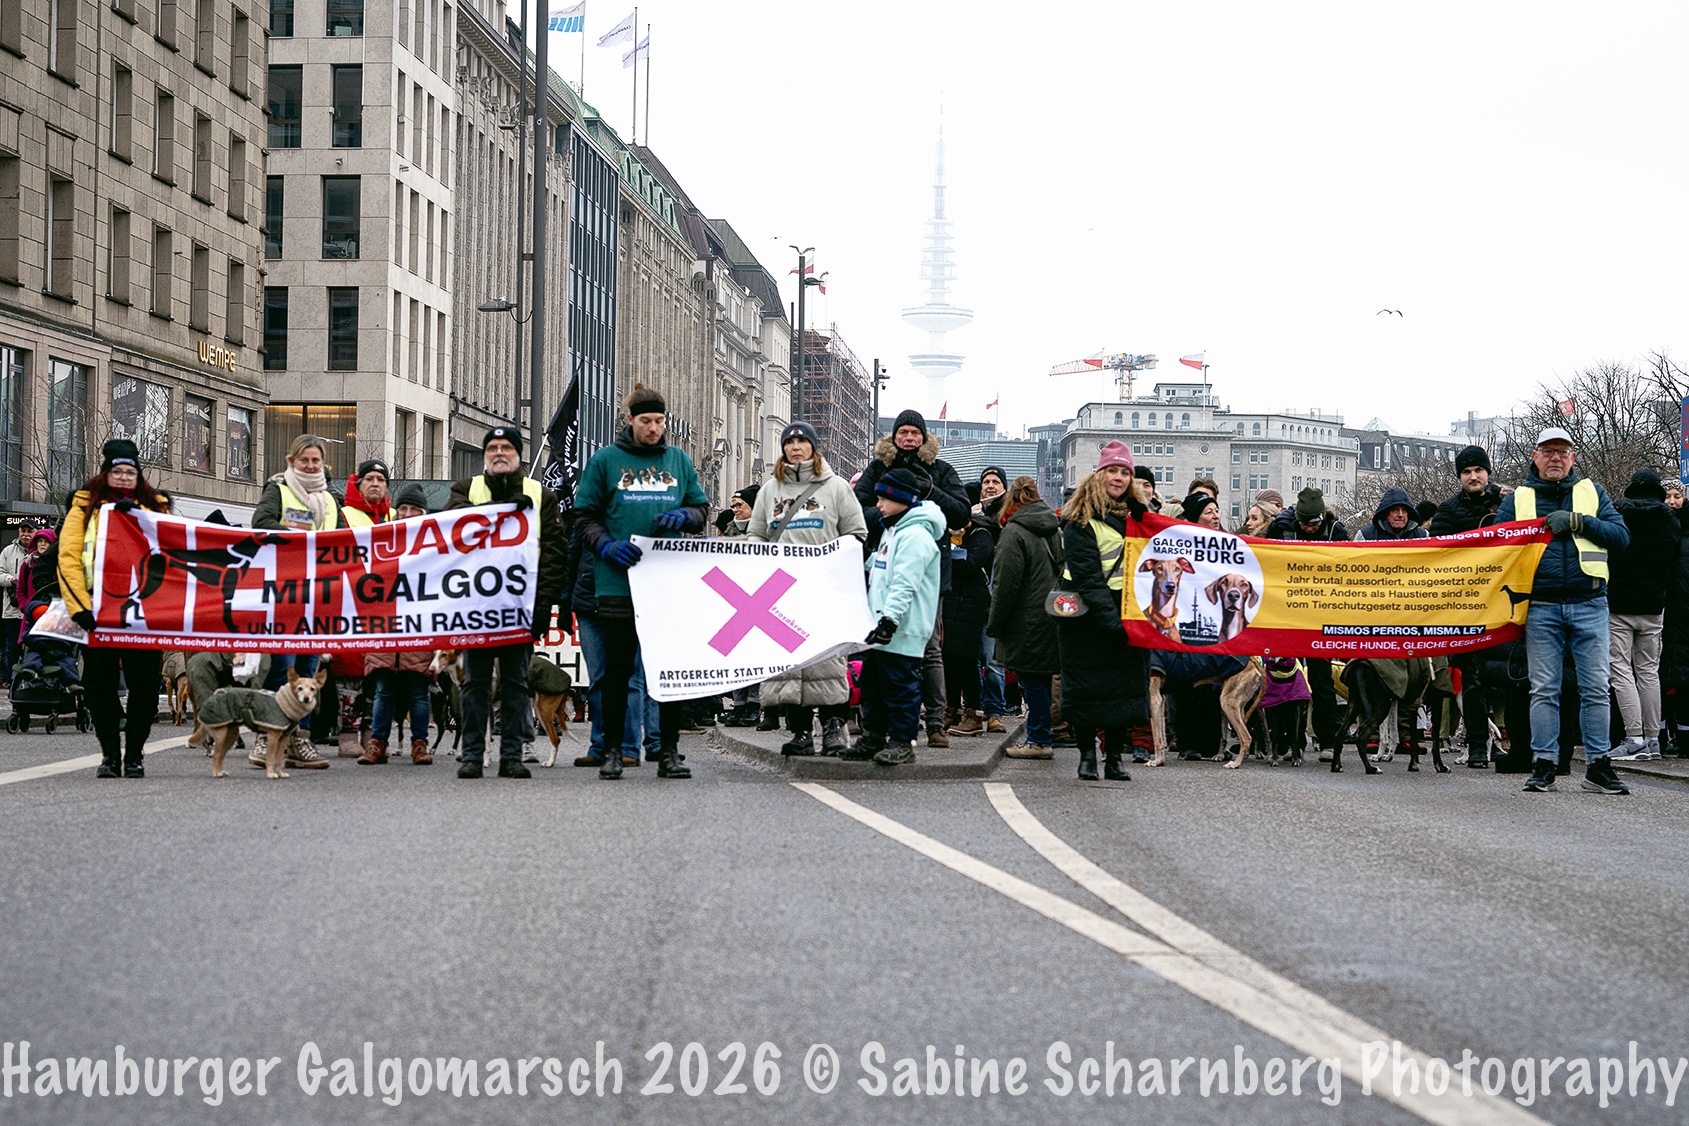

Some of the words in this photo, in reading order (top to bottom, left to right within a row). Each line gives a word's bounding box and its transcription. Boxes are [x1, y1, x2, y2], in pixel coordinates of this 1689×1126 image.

[198, 341, 236, 372] WEMPE
[564, 425, 576, 478] HUMAN
[315, 545, 369, 566] ZUR
[372, 509, 530, 562] JAGD
[1152, 536, 1193, 549] GALGO
[1193, 535, 1238, 551] HAM
[651, 538, 779, 557] MASSENTIERHALTUNG
[783, 539, 841, 558] BEENDEN!
[1152, 545, 1193, 556] MARSCH
[1193, 550, 1246, 565] BURG
[1286, 562, 1315, 574] Mehr
[1317, 562, 1333, 574] als
[1334, 563, 1370, 574] 50.000
[1372, 563, 1431, 576] Jagdhunde
[1433, 563, 1473, 574] werden
[1474, 563, 1503, 576] jedes
[261, 576, 340, 605] MIT
[355, 563, 528, 604] GALGOS
[1286, 575, 1311, 585] Jahr
[1312, 575, 1344, 586] brutal
[1345, 576, 1405, 587] aussortiert,
[1407, 576, 1466, 588] ausgesetzt
[1467, 576, 1491, 587] oder
[1286, 588, 1327, 599] getötet.
[1329, 588, 1368, 599] Anders
[1369, 588, 1386, 599] als
[1388, 588, 1439, 599] Haustiere
[1440, 588, 1463, 599] sind
[1464, 588, 1480, 598] sie
[1285, 600, 1309, 610] vom
[1312, 600, 1402, 612] Tierschutzgesetz
[1403, 601, 1489, 613] ausgeschlossen.
[247, 622, 286, 636] UND
[293, 613, 423, 636] ANDEREN
[431, 607, 532, 632] RASSEN
[1323, 625, 1370, 636] MISMOS
[1372, 625, 1421, 637] PERROS,
[1423, 625, 1460, 636] MISMA
[1461, 625, 1486, 636] LEY
[112, 635, 157, 645] wehrloser
[157, 638, 173, 646] ein
[173, 638, 216, 648] Geschöpf
[217, 639, 232, 649] ist,
[233, 640, 258, 648] desto
[259, 640, 282, 648] mehr
[284, 640, 310, 649] Recht
[311, 640, 326, 648] hat
[342, 639, 385, 649] verteidigt
[385, 640, 396, 648] zu
[1311, 640, 1358, 650] GLEICHE
[1359, 640, 1401, 651] HUNDE,
[1402, 640, 1449, 650] GLEICHE
[1449, 634, 1493, 648] GESETZE
[659, 669, 730, 681] ARTGERECHT
[733, 666, 764, 678] STATT
